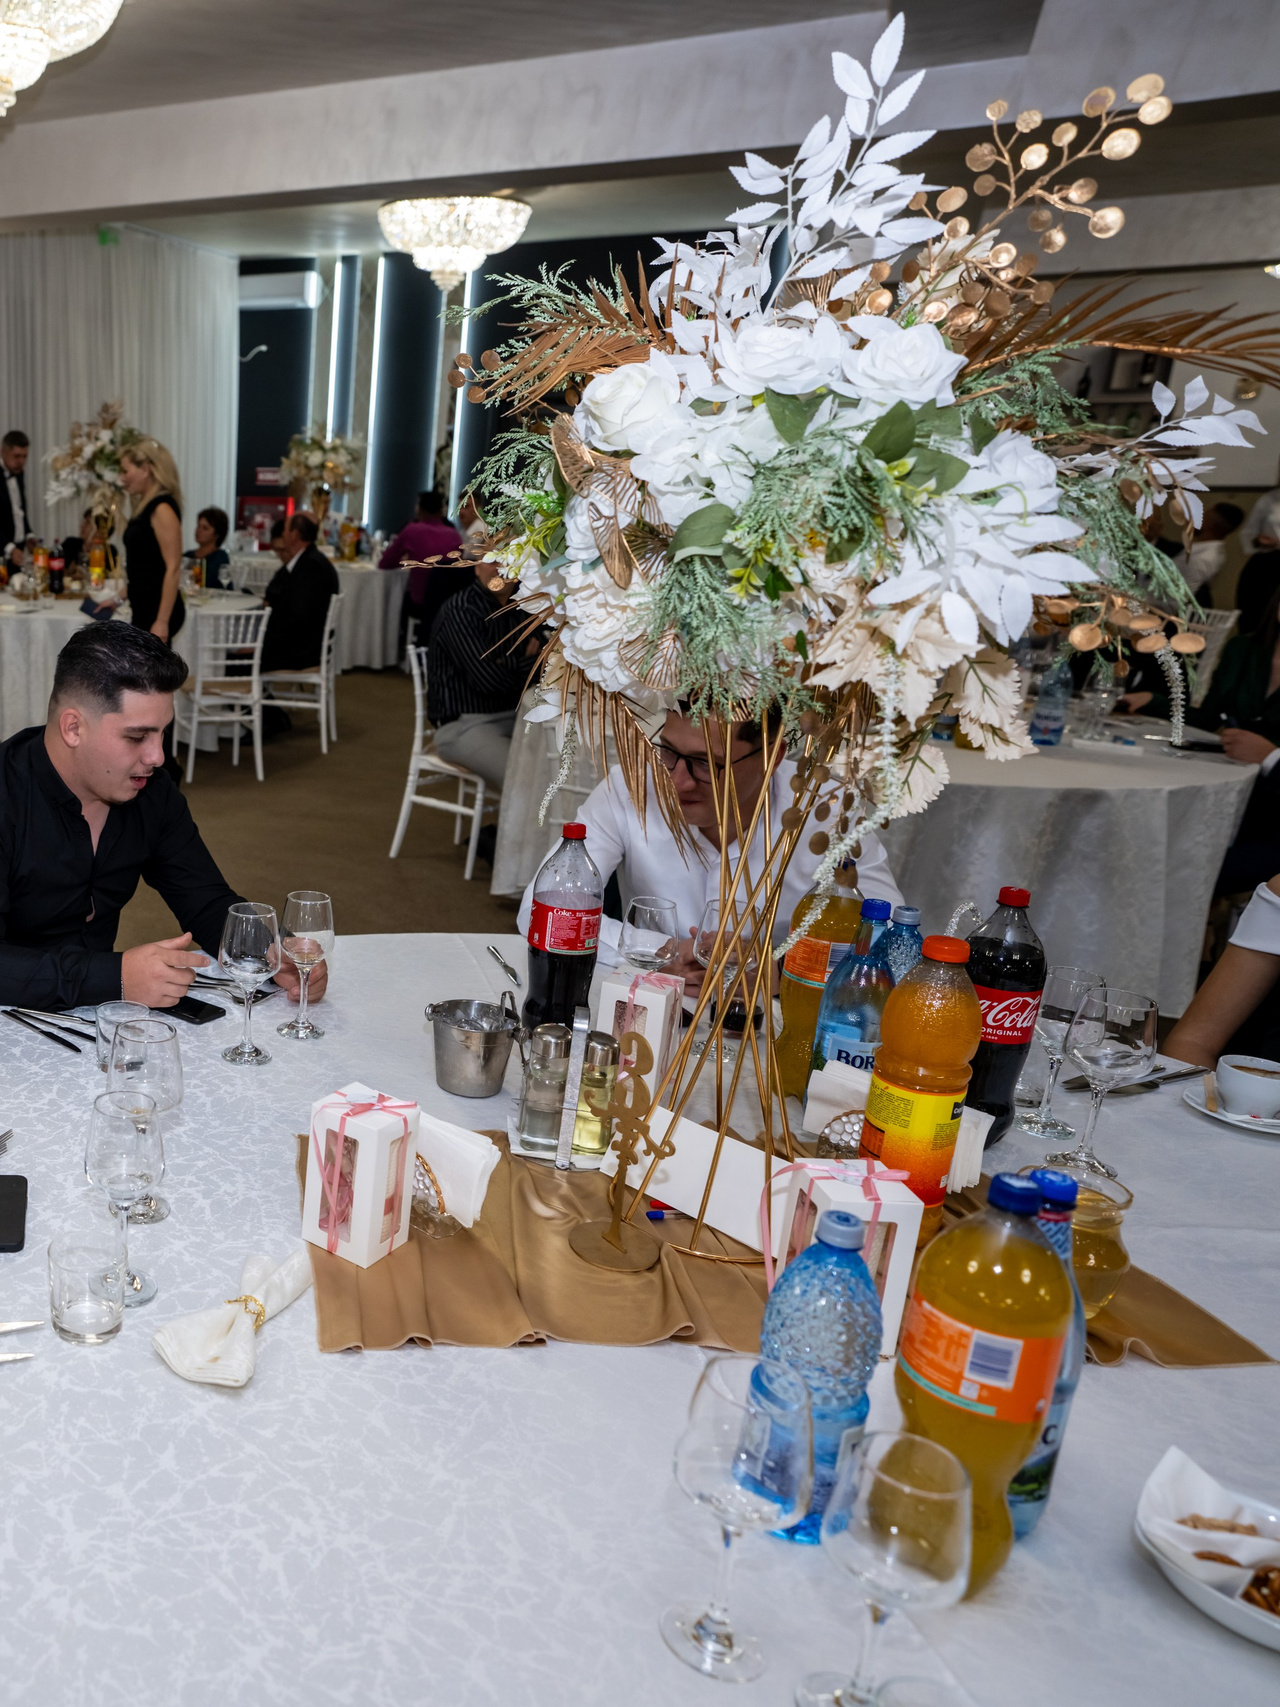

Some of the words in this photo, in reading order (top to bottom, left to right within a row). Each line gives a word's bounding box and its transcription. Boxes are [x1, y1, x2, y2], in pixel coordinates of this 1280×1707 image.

[553, 908, 572, 917] Coke
[979, 995, 1040, 1028] a-Cola
[981, 1027, 1022, 1036] ORIGINAL
[836, 1048, 875, 1069] BOR
